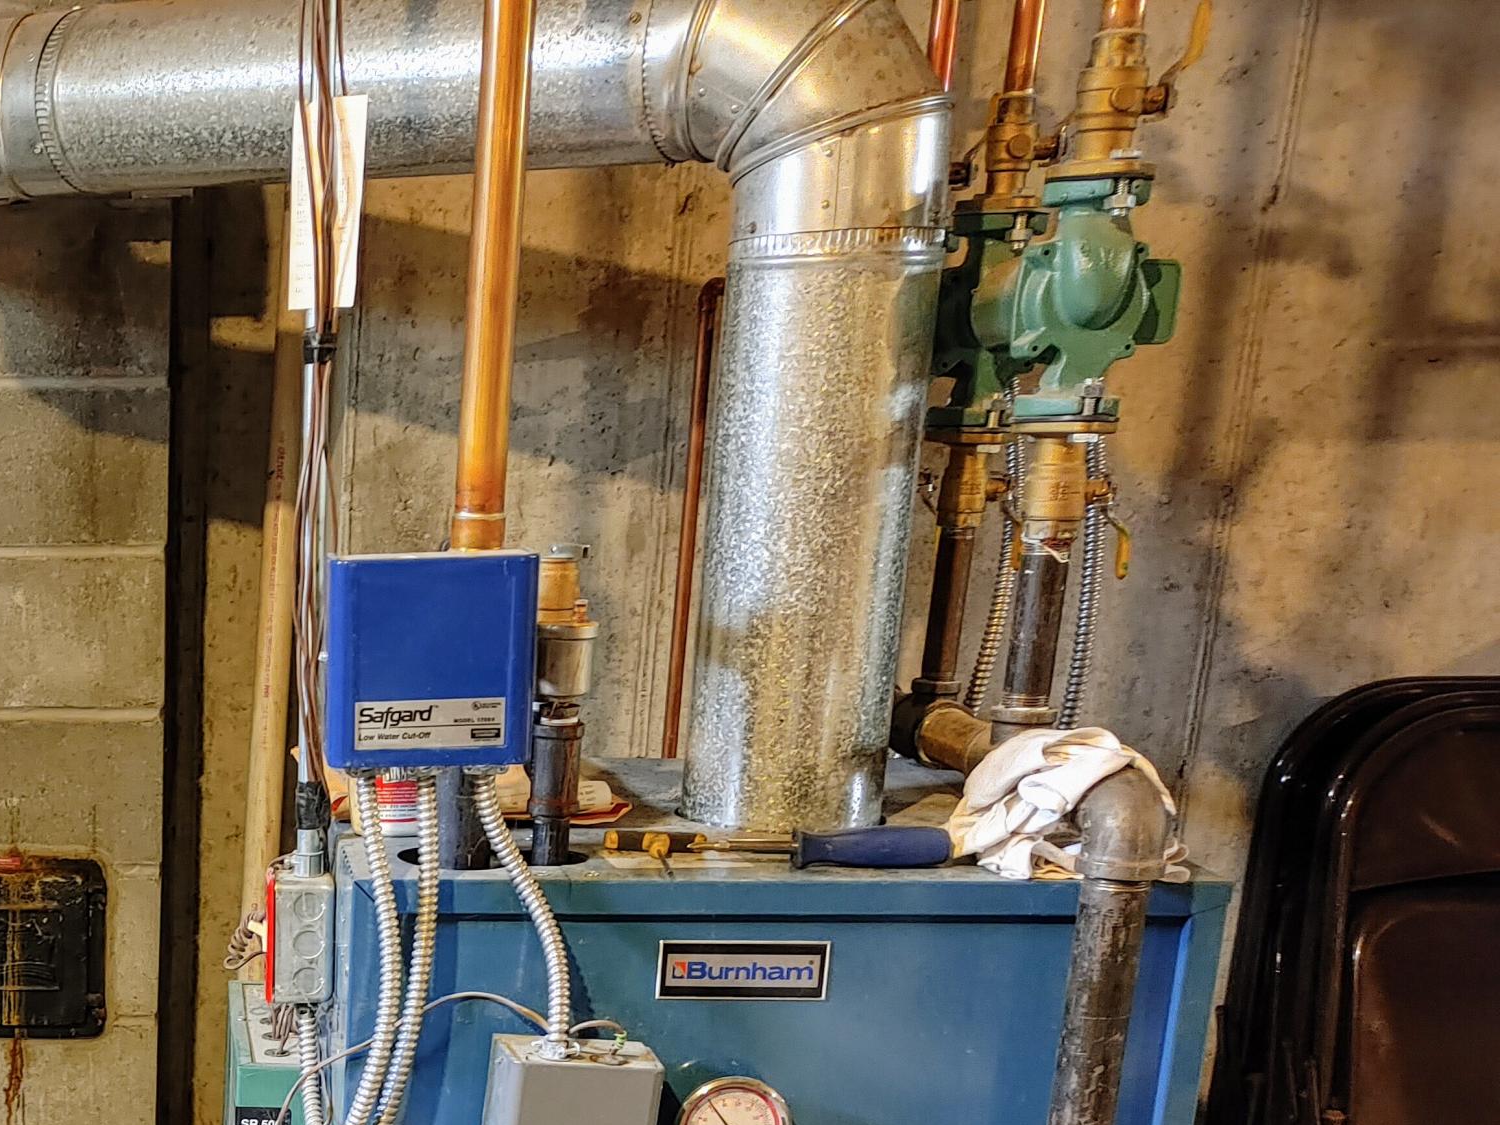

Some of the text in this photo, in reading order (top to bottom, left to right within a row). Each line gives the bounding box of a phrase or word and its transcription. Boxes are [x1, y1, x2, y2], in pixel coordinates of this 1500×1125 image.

[358, 705, 433, 728] Safgard
[358, 731, 431, 741] Low Water Cut-Off
[686, 961, 814, 981] Burnham
